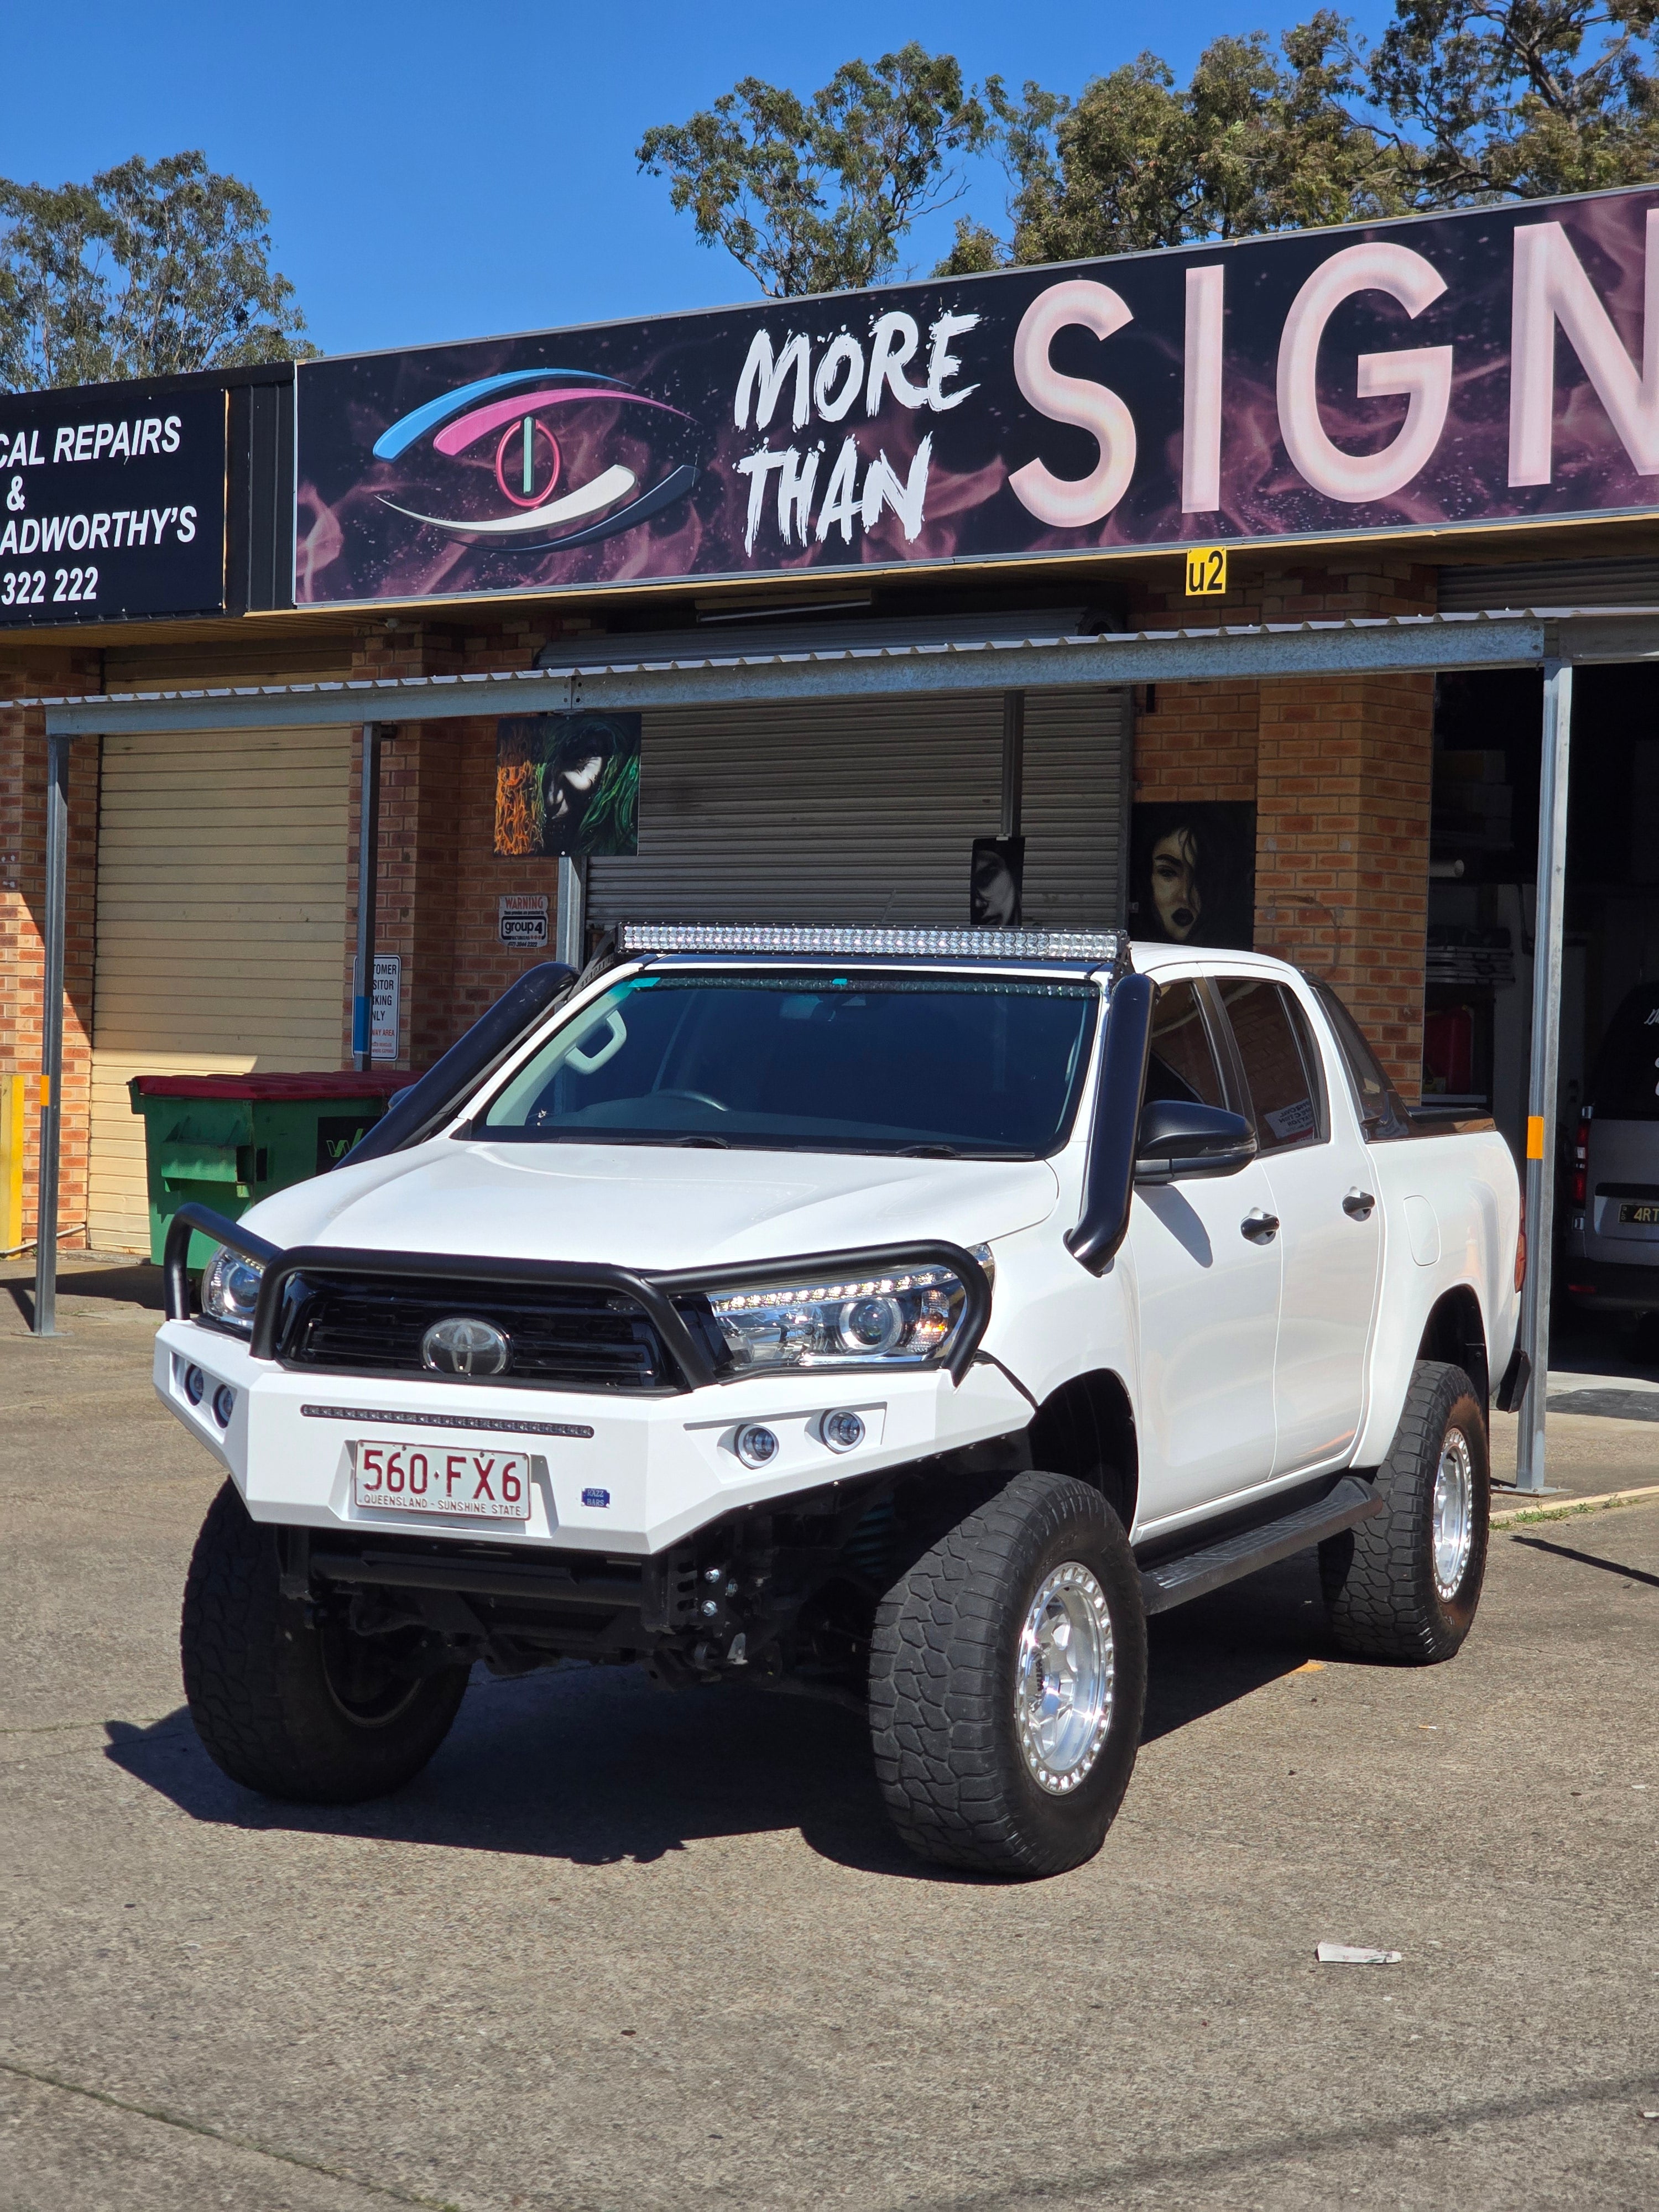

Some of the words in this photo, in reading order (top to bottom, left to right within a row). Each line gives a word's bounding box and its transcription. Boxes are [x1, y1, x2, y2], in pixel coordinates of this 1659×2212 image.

[734, 310, 983, 432] MORE
[53, 415, 181, 463] REPAIRS
[7, 476, 25, 511] &
[733, 431, 933, 557] THAN
[1, 570, 45, 605] 322
[53, 567, 98, 602] 222
[1189, 550, 1223, 592] u2
[505, 896, 544, 910] WARNING
[373, 980, 394, 990] SITOR
[372, 1010, 385, 1021] NLY
[364, 1494, 427, 1508] QUEENSLAND
[438, 1499, 486, 1514] SUNSHINE
[492, 1504, 521, 1516] STATE
